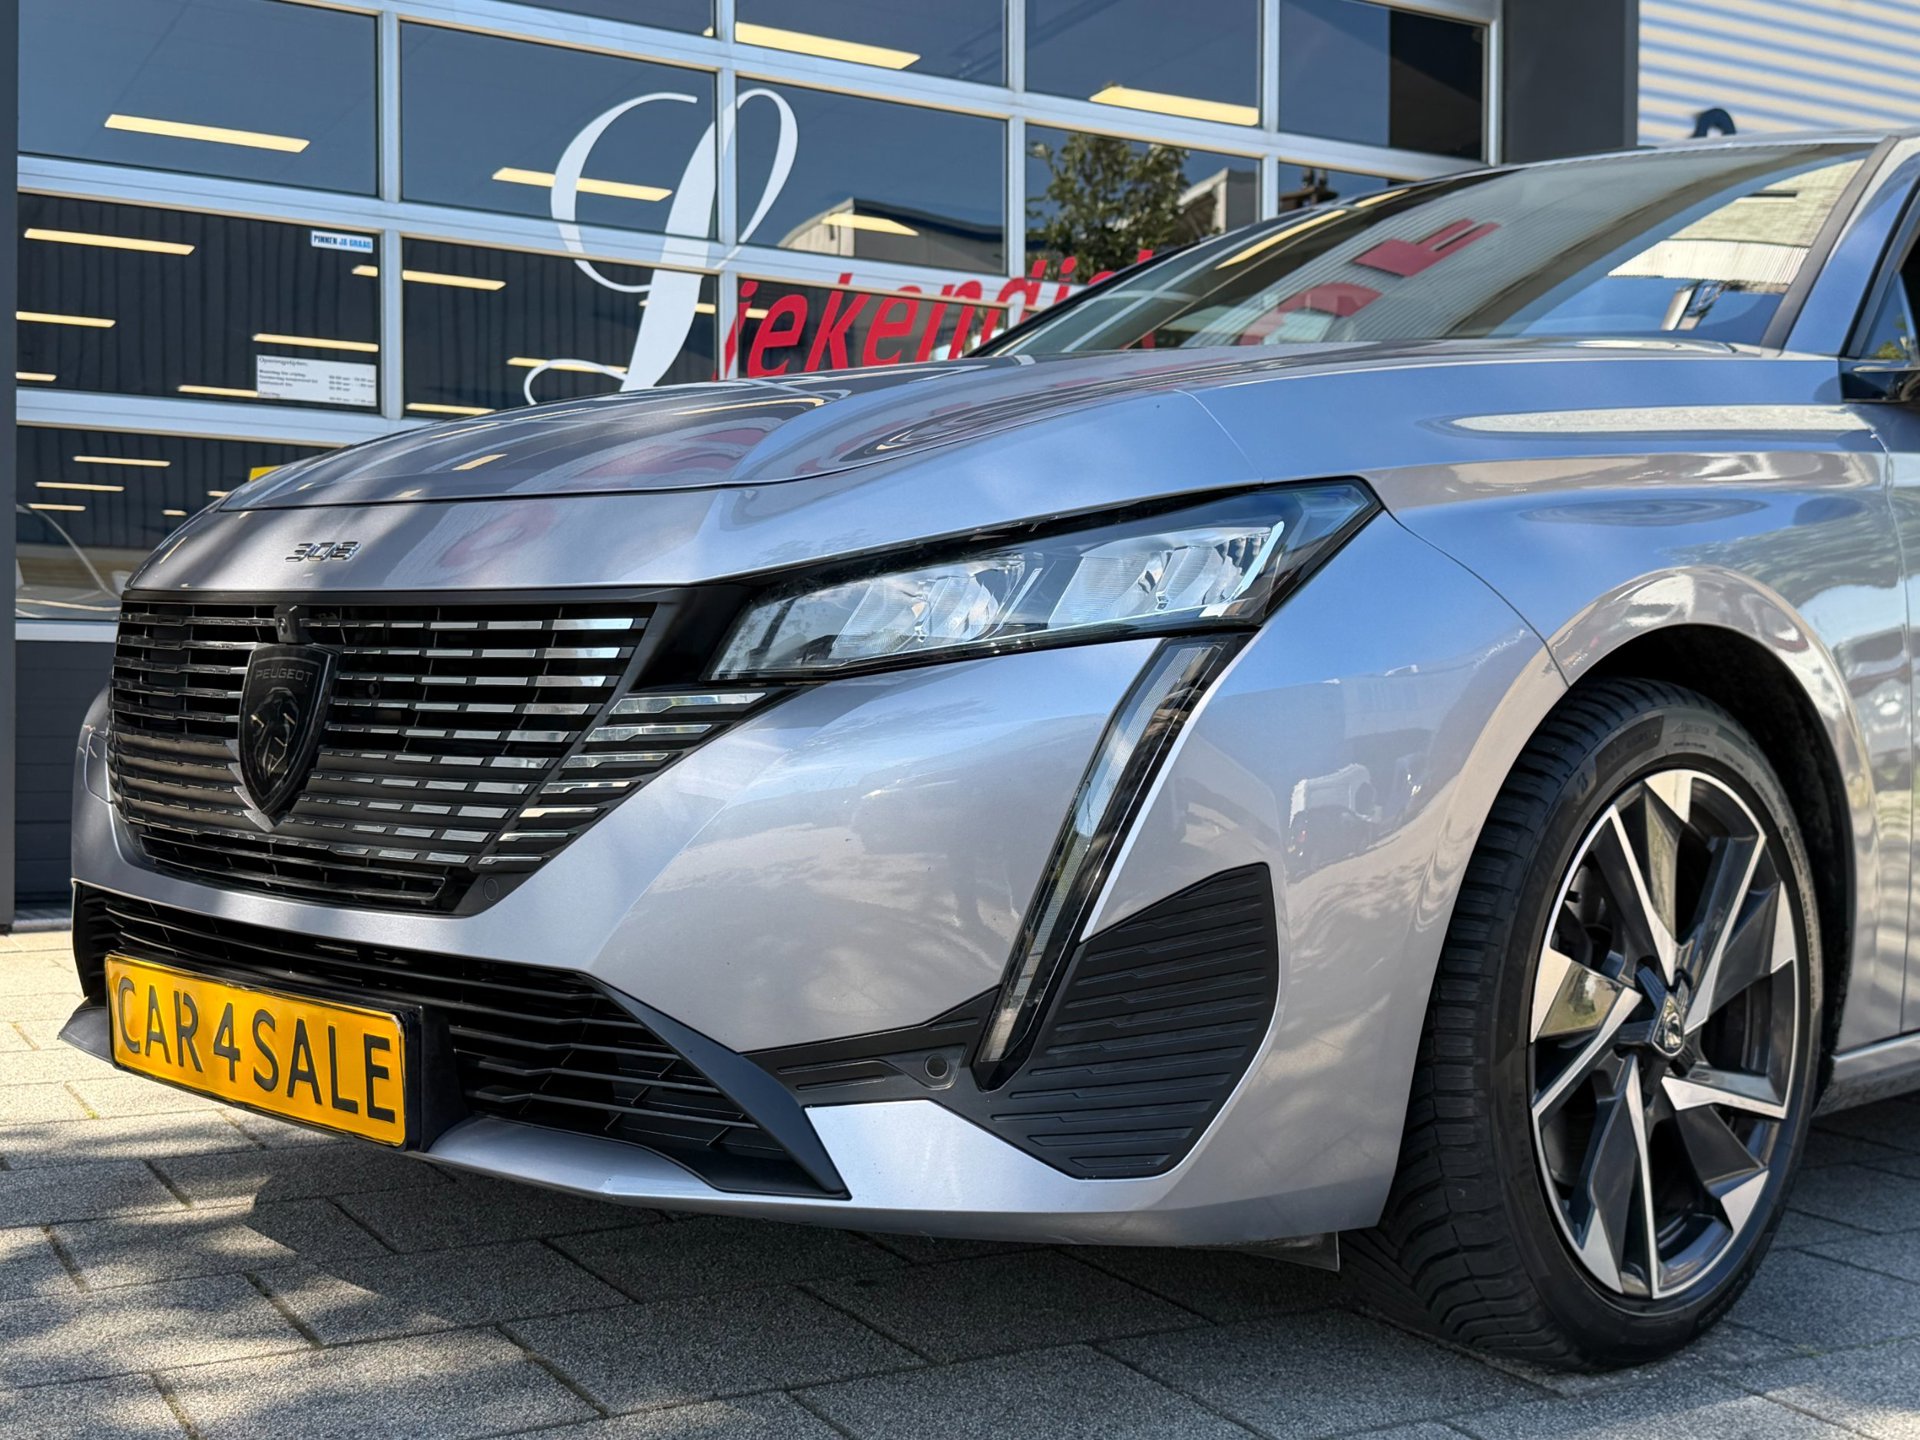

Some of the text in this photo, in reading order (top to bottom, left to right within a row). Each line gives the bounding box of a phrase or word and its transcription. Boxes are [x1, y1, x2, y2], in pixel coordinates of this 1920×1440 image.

[524, 88, 1153, 406] Liekendi
[285, 541, 361, 562] 308
[255, 667, 313, 682] PEUGEOT
